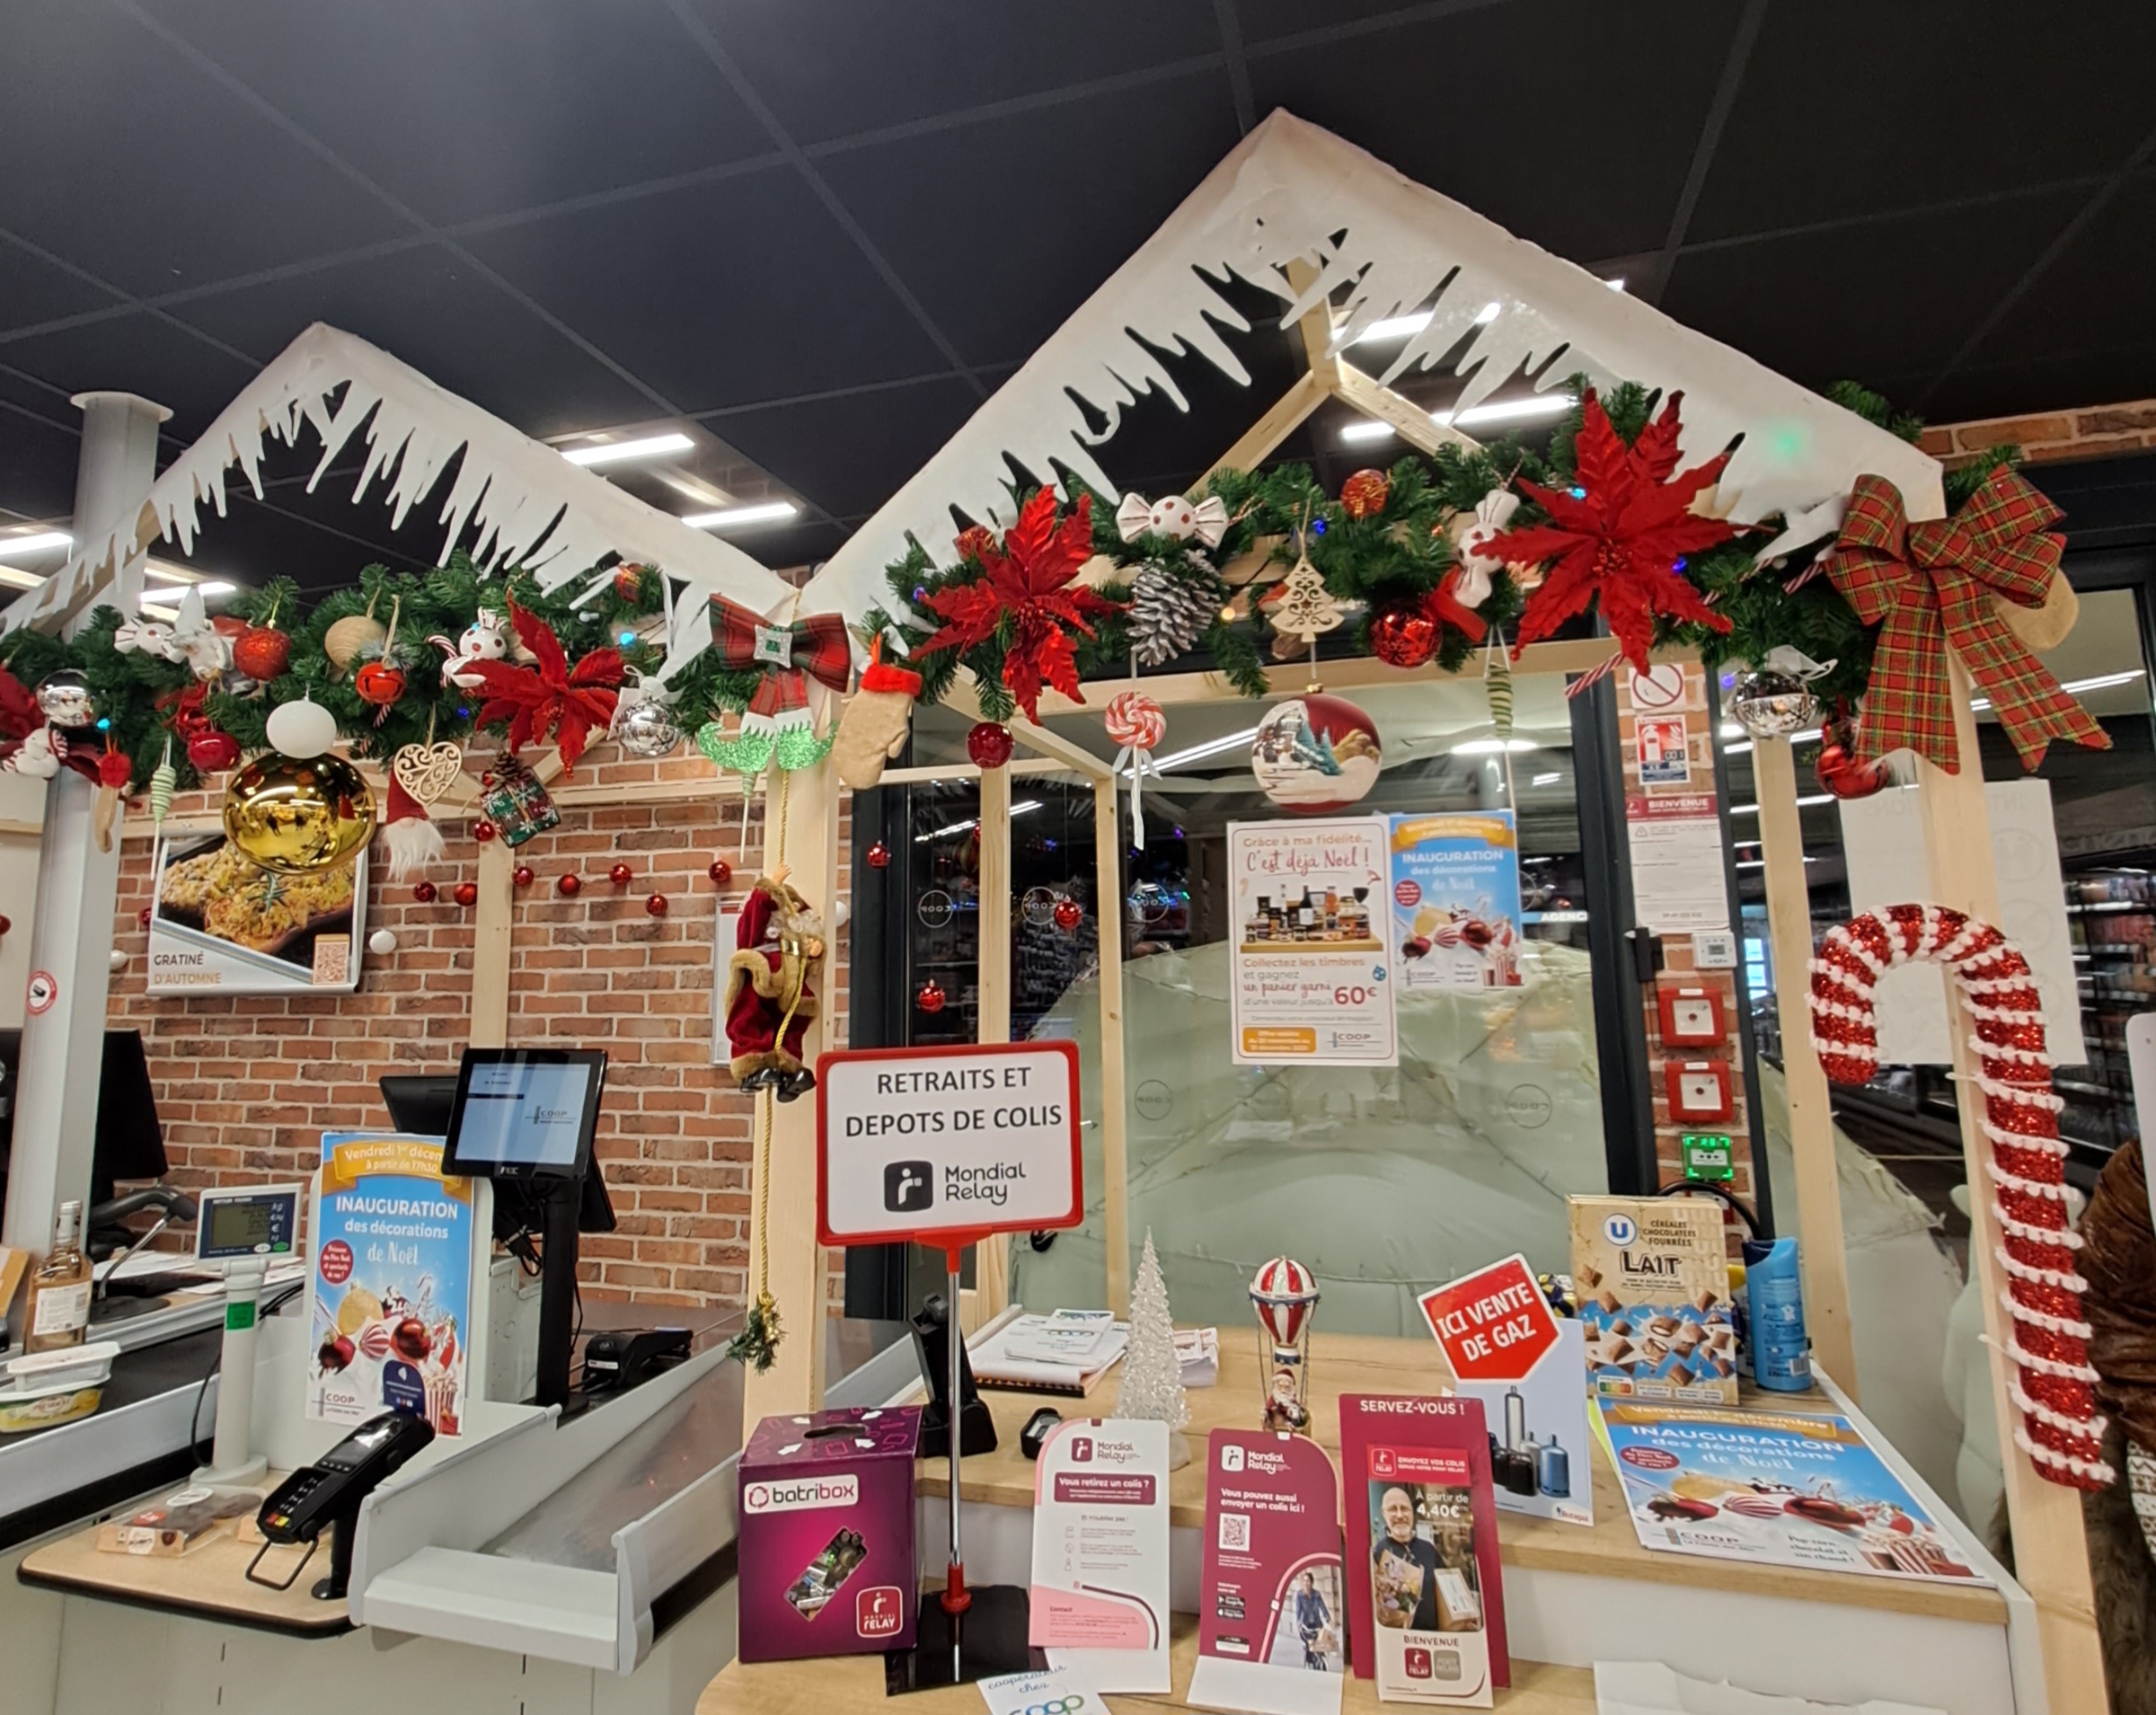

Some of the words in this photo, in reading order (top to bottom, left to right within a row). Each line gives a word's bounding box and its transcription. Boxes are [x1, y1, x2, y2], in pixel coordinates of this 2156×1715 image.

[1648, 799, 1709, 809] BIENVENUE
[1243, 837, 1278, 847] Grâce
[1282, 836, 1289, 845] à
[1294, 836, 1312, 845] ma
[1247, 850, 1282, 872] C'est
[1402, 850, 1504, 863] INAUGURATION
[1410, 866, 1429, 875] des
[1432, 864, 1497, 874] décorations
[154, 950, 205, 966] GRATINÉ
[1243, 958, 1297, 968] Collectez
[1299, 958, 1316, 968] les
[1319, 958, 1365, 967] timbres
[155, 972, 222, 985] D'AUTOMNE
[1243, 970, 1255, 979] et
[1258, 970, 1300, 981] gagnez
[1261, 982, 1297, 997] panier
[878, 1069, 995, 1094] RETRAITS
[1003, 1066, 1031, 1087] ET
[541, 1109, 568, 1118] COOP
[846, 1111, 944, 1137] DEPOTS
[953, 1109, 985, 1131] DE
[994, 1105, 1062, 1128] COLIS
[344, 1145, 394, 1161] Vendredi
[373, 1160, 397, 1171] partir
[412, 1160, 438, 1173] 17h30
[945, 1162, 1026, 1182] Mondial
[945, 1183, 1008, 1206] Relay
[336, 1196, 458, 1220] INAUGURATION
[344, 1218, 367, 1233] des
[370, 1219, 448, 1239] décorations
[1650, 1218, 1687, 1228] CÉRÉALES
[1611, 1222, 1629, 1239] U
[1643, 1228, 1696, 1237] CHOCOLATÉES
[1648, 1237, 1692, 1247] FOURRÉES
[367, 1242, 384, 1262] de
[388, 1240, 419, 1266] Noël
[1623, 1251, 1680, 1276] LAIT
[1436, 1310, 1470, 1339] ICI
[1465, 1282, 1534, 1325] VENTE
[1461, 1333, 1492, 1362] DE
[1492, 1313, 1537, 1348] GAZ
[325, 1393, 355, 1403] COOP
[1360, 1400, 1456, 1415] SERVEZ-VOUS
[1460, 1405, 1464, 1415] !
[1630, 1426, 1845, 1452] INAUGURATION
[1098, 1442, 1133, 1452] Mondial
[1651, 1437, 1692, 1448] des
[1697, 1441, 1836, 1461] décorations
[1098, 1450, 1125, 1463] Relay
[1248, 1451, 1285, 1463] Mondial
[1398, 1456, 1429, 1465] ENVOYEZ
[1701, 1453, 1729, 1463] de
[1737, 1453, 1795, 1470] Noël
[1248, 1460, 1276, 1474] Relay
[1059, 1478, 1080, 1486] Vous
[1082, 1478, 1108, 1487] retirez
[1123, 1479, 1142, 1488] colis
[1144, 1480, 1149, 1488] ?
[773, 1484, 853, 1503] batribox
[1221, 1488, 1241, 1498] Vous
[1243, 1491, 1273, 1501] pouvez
[1275, 1493, 1297, 1502] aussi
[1416, 1489, 1425, 1500] À
[1426, 1492, 1453, 1502] partir
[1455, 1494, 1469, 1503] de
[1221, 1498, 1254, 1509] envoyer
[1256, 1501, 1267, 1509] un
[1268, 1501, 1288, 1511] colis
[1289, 1503, 1300, 1513] ici
[1416, 1503, 1460, 1518] 4,40€
[1680, 1532, 1739, 1543] COOP
[1403, 1635, 1459, 1647] BIENVENUE
